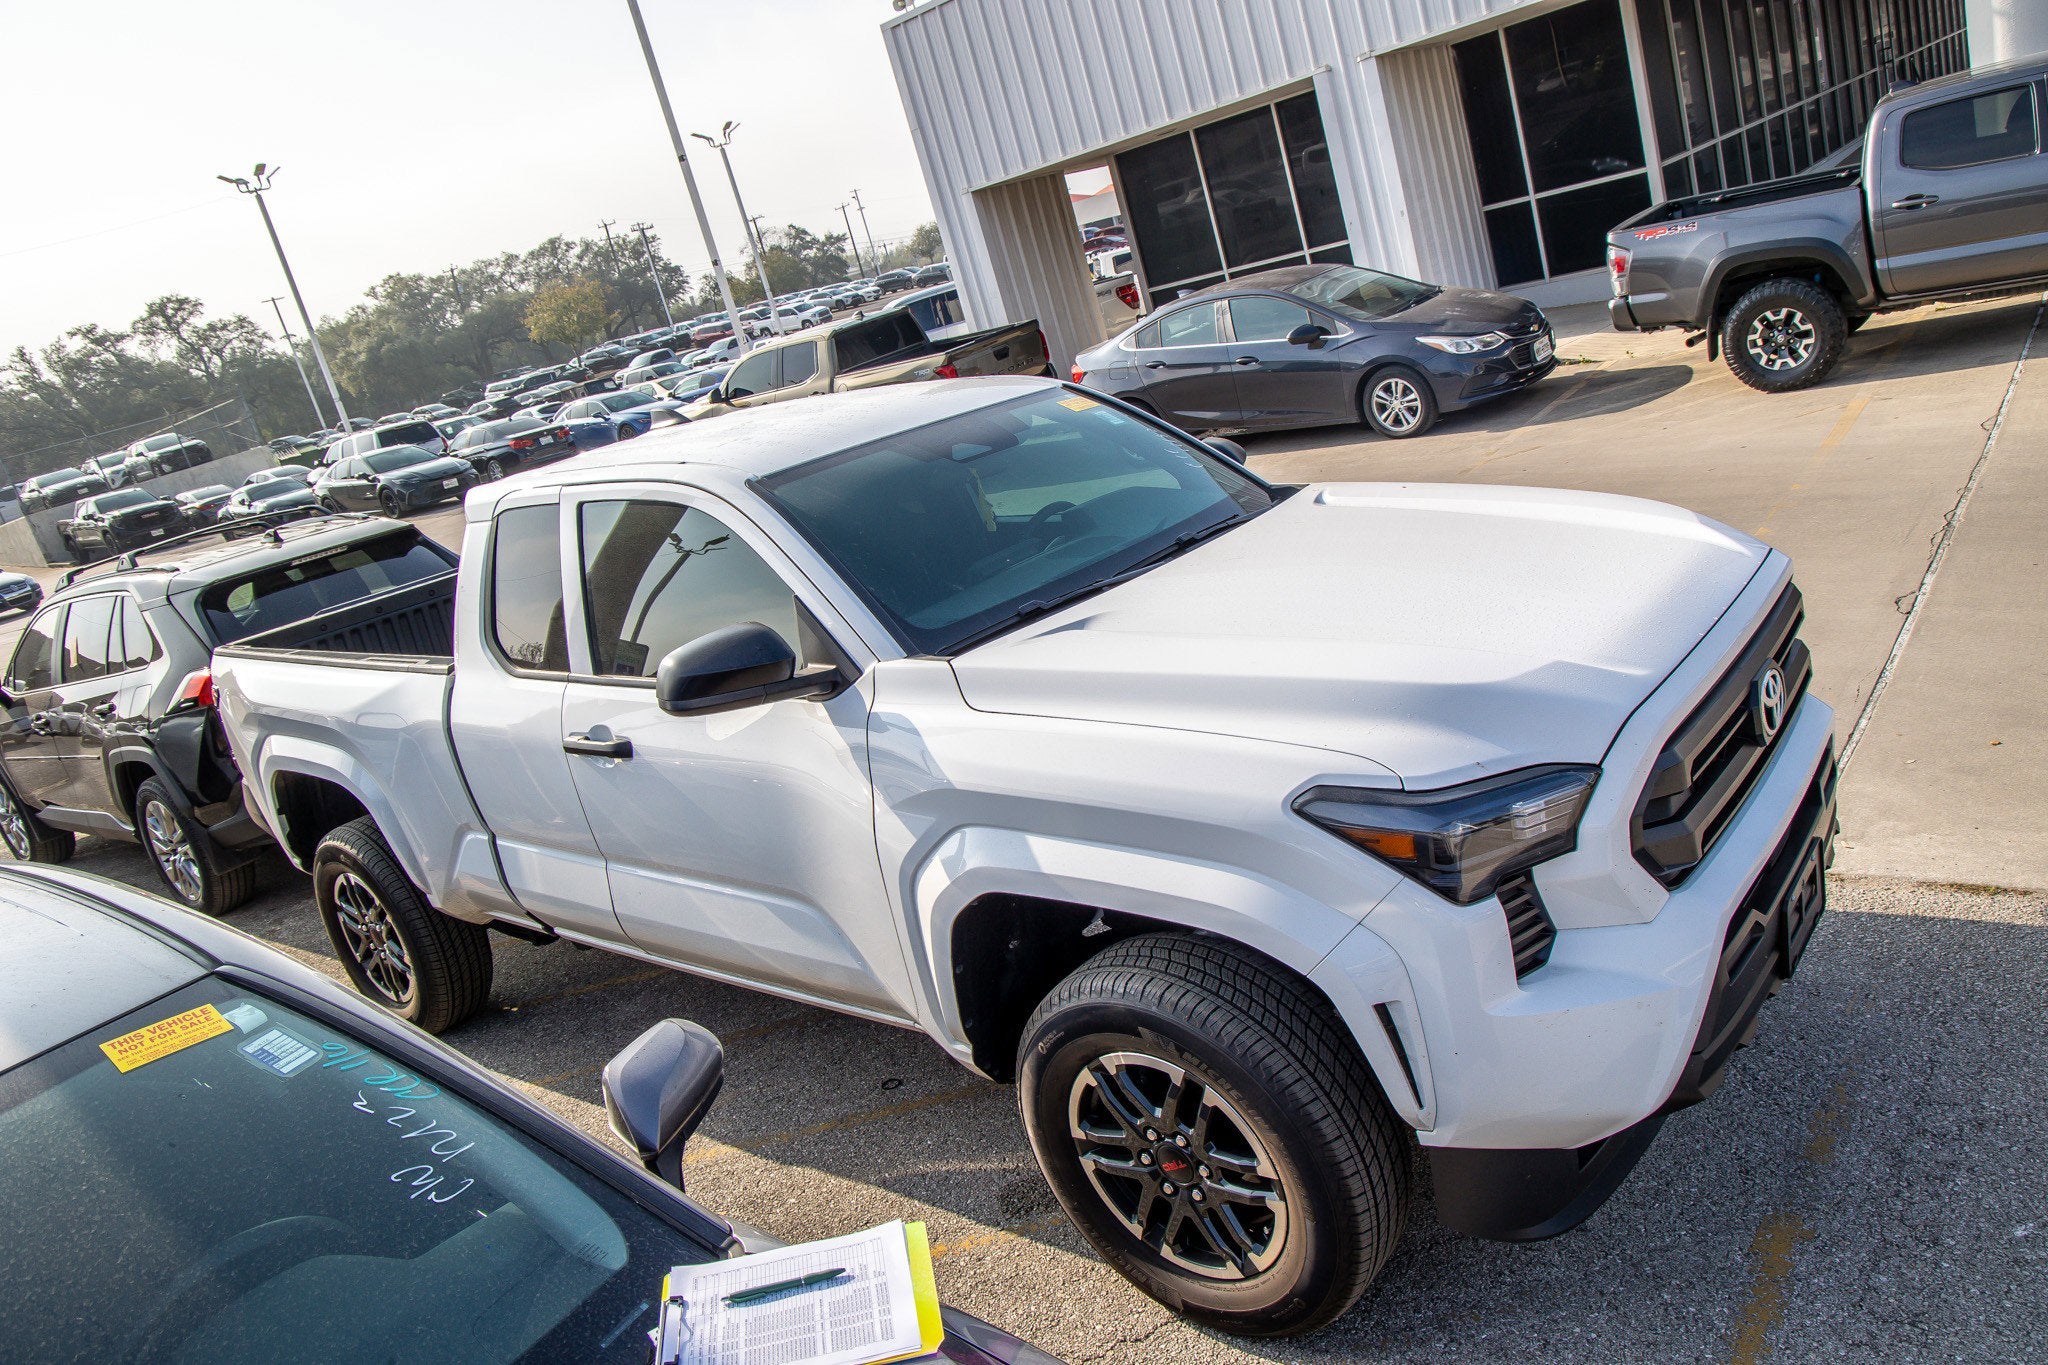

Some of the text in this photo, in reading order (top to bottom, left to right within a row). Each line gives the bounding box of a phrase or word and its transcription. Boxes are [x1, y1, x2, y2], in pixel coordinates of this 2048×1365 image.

[107, 1032, 146, 1051] THIS
[146, 1007, 213, 1035] VEHICLE
[117, 1015, 215, 1056] NOT FOR SALE
